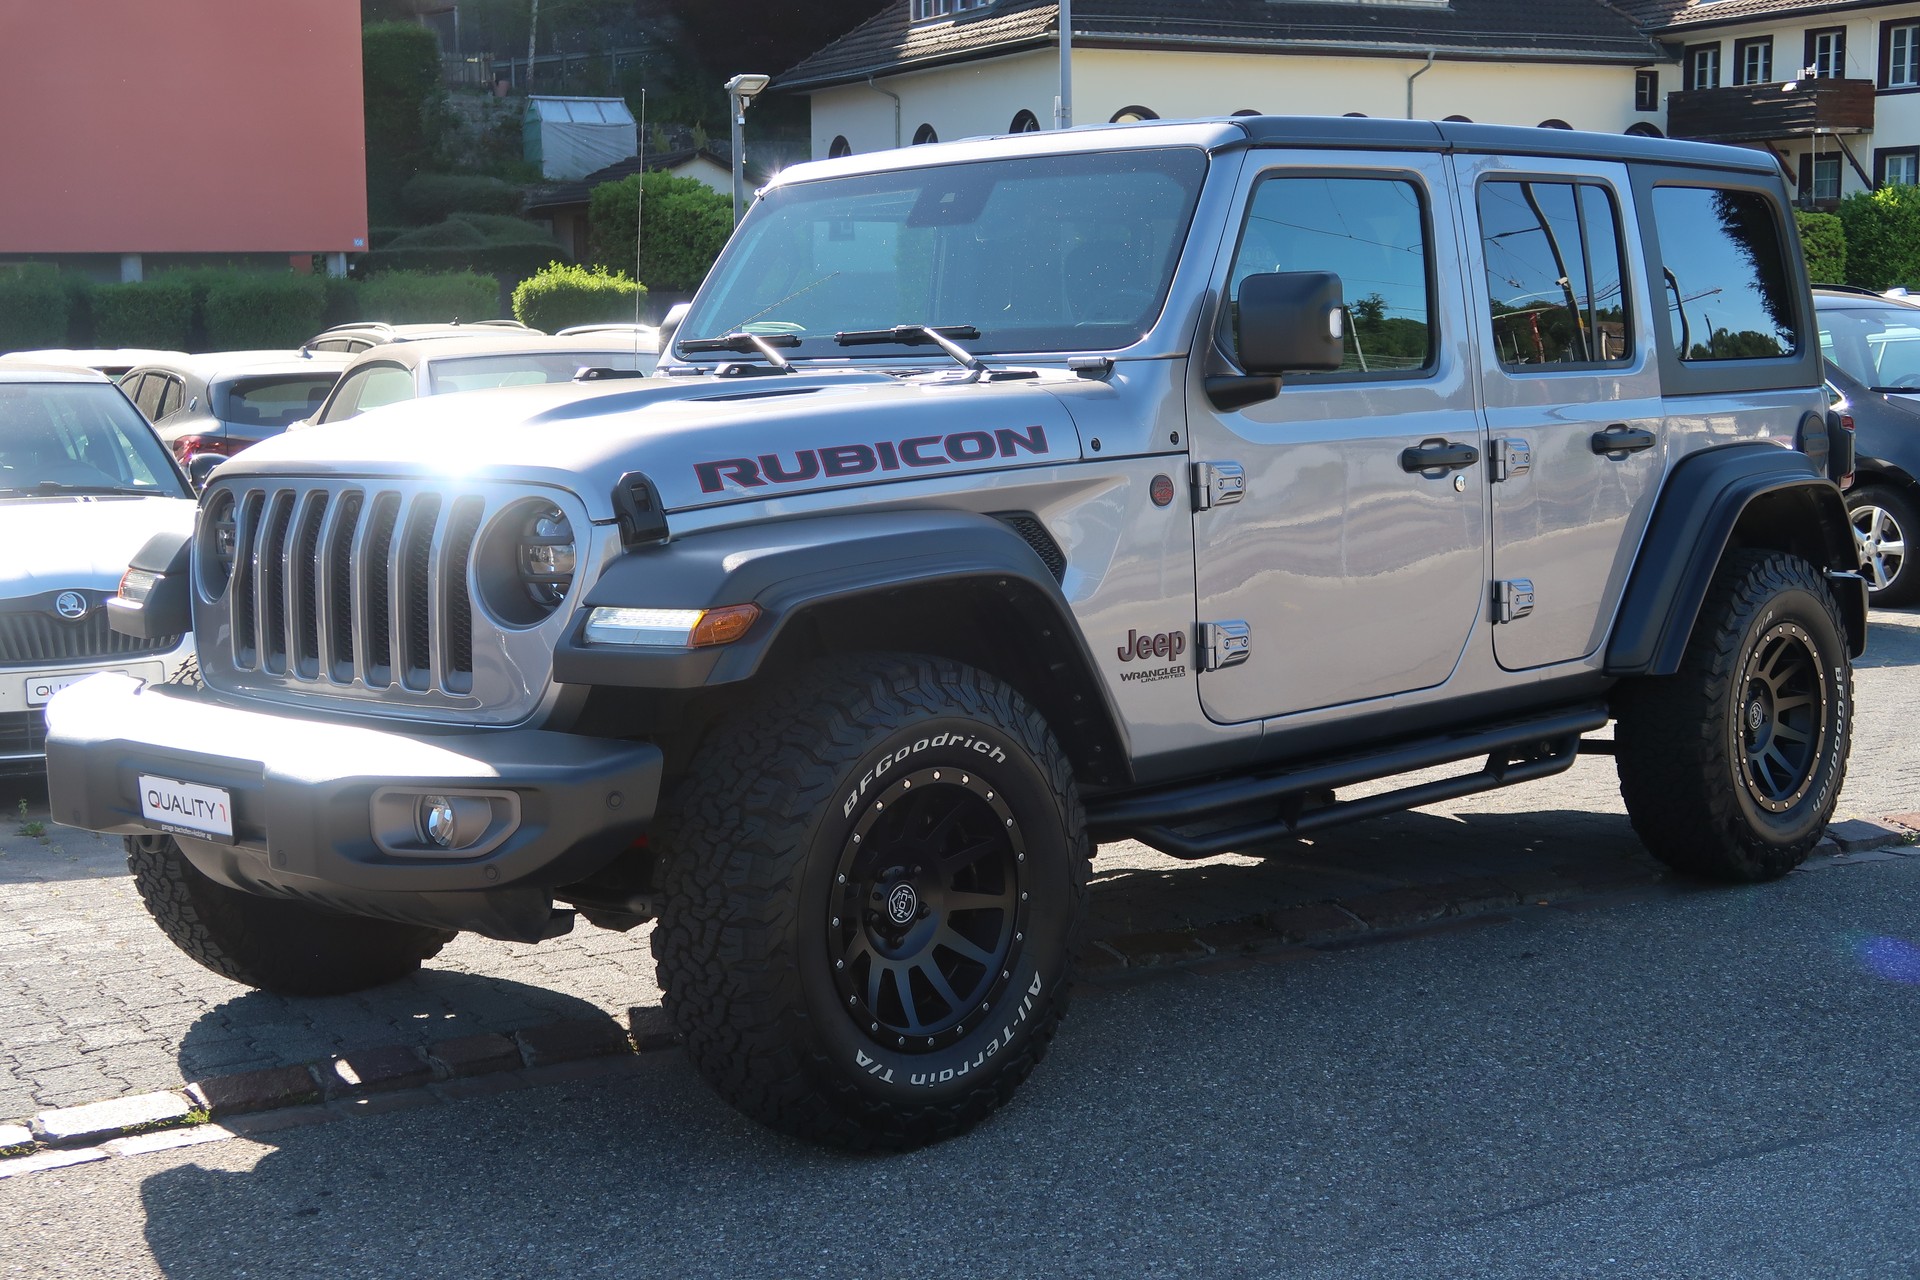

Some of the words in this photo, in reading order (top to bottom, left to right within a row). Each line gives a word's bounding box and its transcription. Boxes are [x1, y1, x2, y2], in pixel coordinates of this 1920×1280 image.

[693, 425, 1049, 493] RUBICON
[1117, 629, 1186, 662] Jeep
[1120, 665, 1186, 682] WRANGLER
[1140, 673, 1186, 683] UNLIMITED
[1812, 667, 1845, 812] BFGoodrich
[842, 732, 1007, 819] BFGoodrich
[897, 890, 909, 918] ICON
[910, 971, 1042, 1087] All-Terrain
[855, 1049, 894, 1085] T/A
